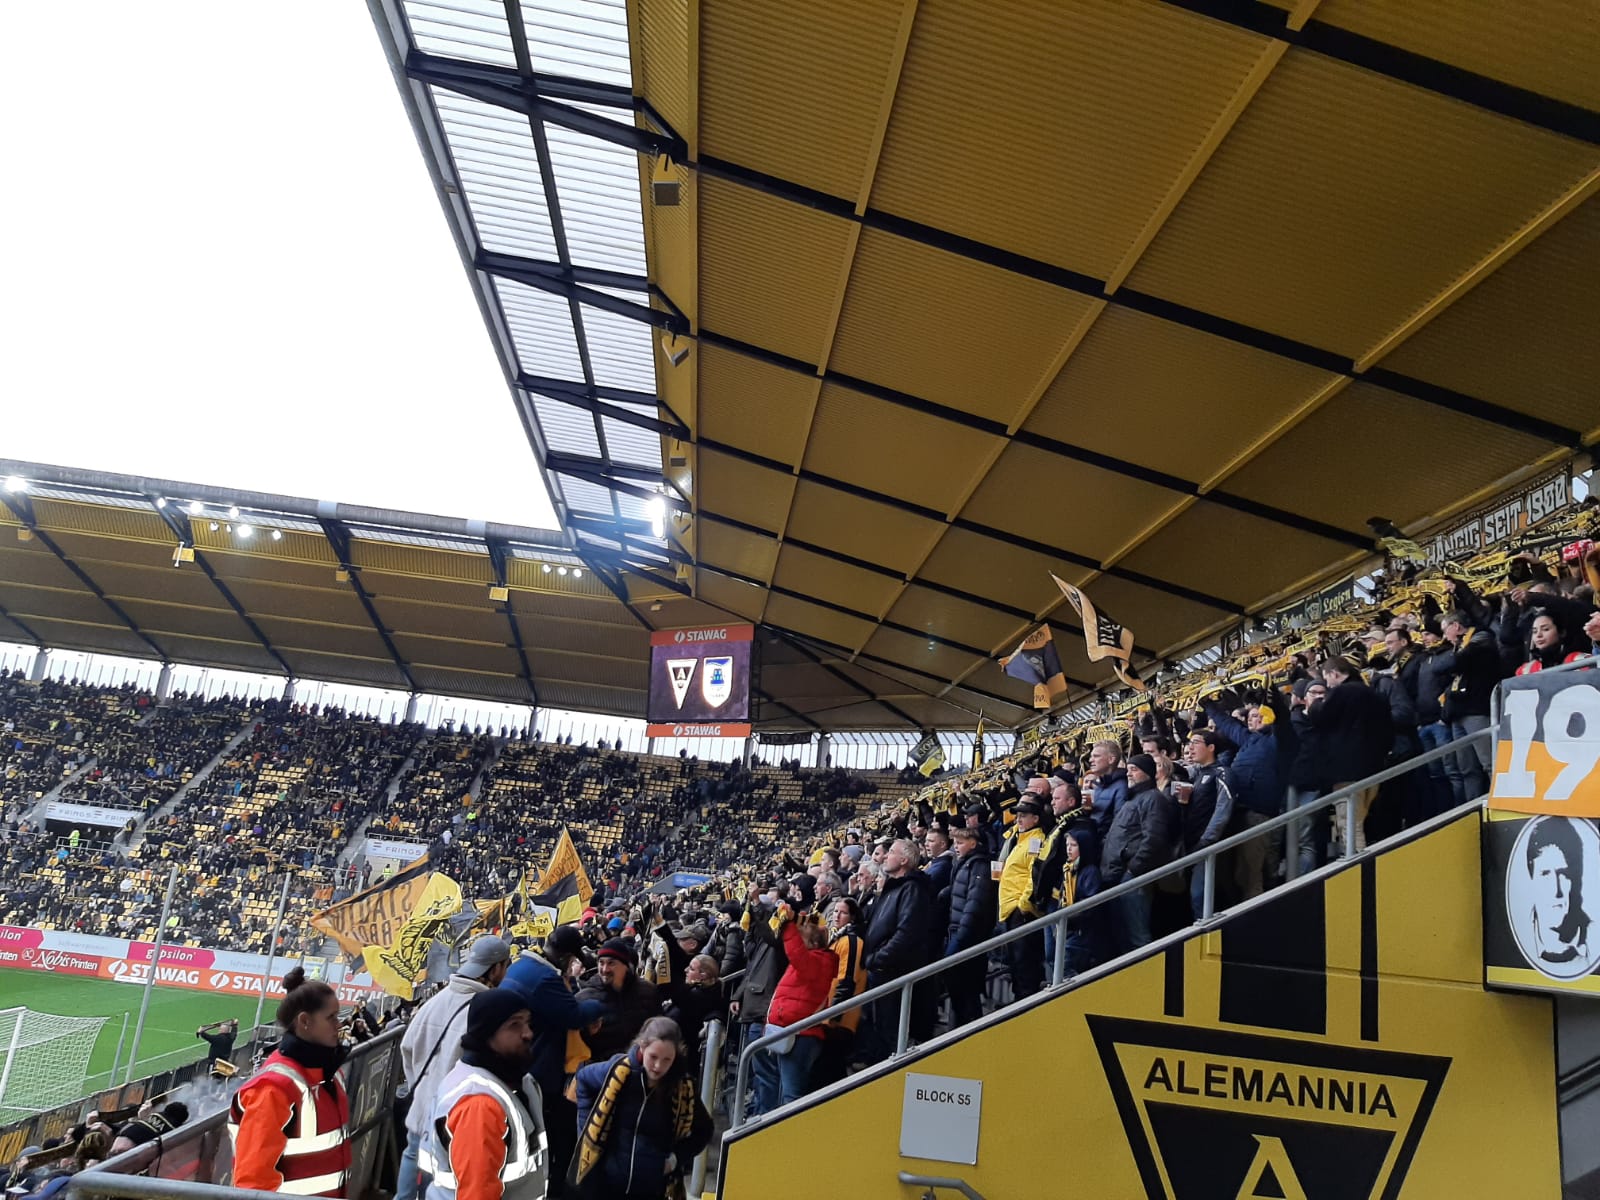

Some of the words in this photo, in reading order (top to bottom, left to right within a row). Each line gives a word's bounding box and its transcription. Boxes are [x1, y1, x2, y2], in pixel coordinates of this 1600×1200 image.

[1484, 501, 1521, 545] SEIT
[1525, 474, 1568, 526] 1900
[687, 629, 727, 641] STAWAG
[684, 725, 721, 735] STAWAG
[1492, 684, 1600, 799] 19
[385, 846, 422, 856] FRINGS
[0, 929, 21, 940] ilon
[145, 949, 193, 961] gpsilon
[70, 957, 98, 971] Printen
[130, 963, 200, 985] STAWAG
[232, 975, 288, 994] STAWA
[1143, 1057, 1398, 1119] ALEMANNIA
[916, 1088, 955, 1104] BLOCK
[957, 1093, 971, 1106] S5
